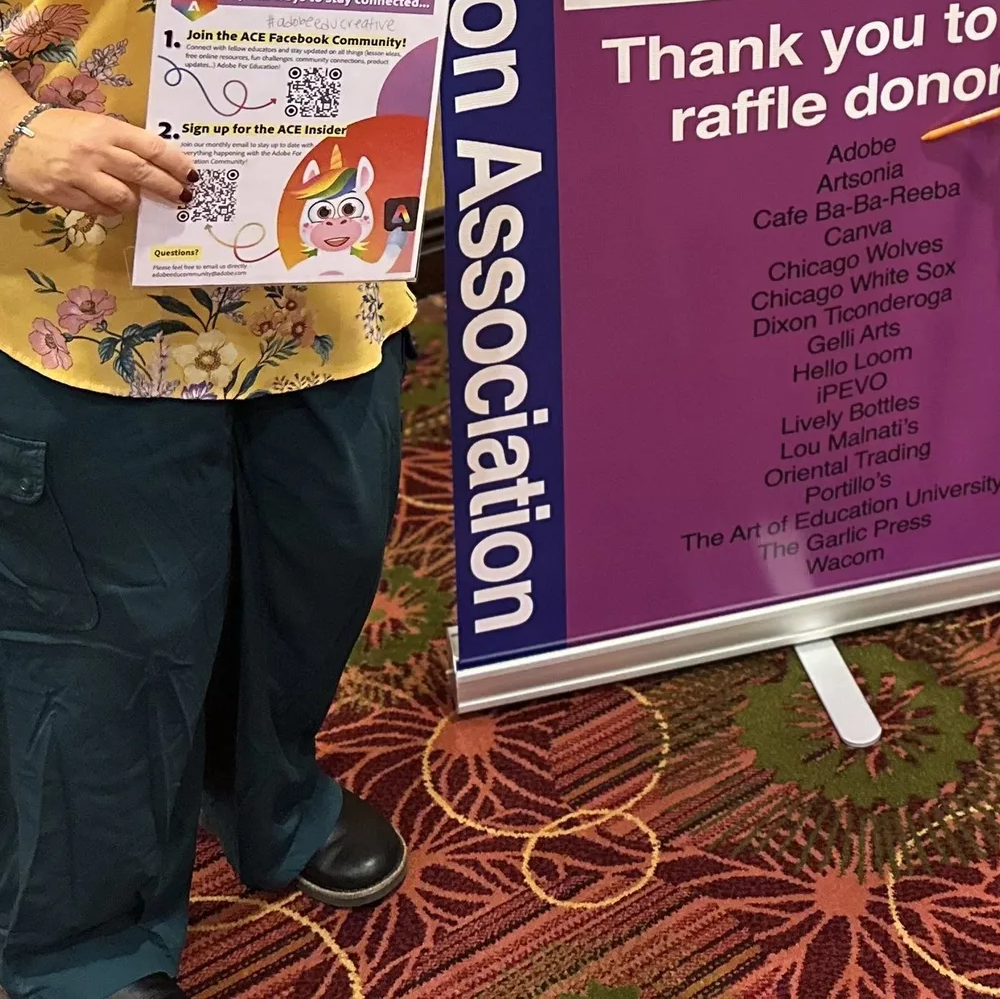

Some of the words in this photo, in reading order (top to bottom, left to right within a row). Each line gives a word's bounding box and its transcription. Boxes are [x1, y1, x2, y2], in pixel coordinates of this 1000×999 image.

[164, 29, 181, 48] 1.
[187, 29, 214, 41] Join
[217, 30, 238, 42] the
[240, 32, 266, 42] ACE
[269, 32, 330, 45] Facebook
[332, 35, 407, 49] Community!
[303, 47, 328, 55] updated
[601, 23, 804, 85] Thank
[820, 12, 925, 75] you
[943, 1, 998, 44] to
[216, 61, 237, 69] Adobe
[238, 62, 248, 70] For
[158, 121, 180, 140] 2.
[182, 123, 210, 136] Sign
[213, 125, 230, 136] up
[232, 123, 251, 134] for
[254, 124, 275, 134] the
[277, 124, 302, 135] ACE
[304, 124, 347, 135] Insider
[671, 87, 827, 142] raffle
[826, 137, 897, 165] Adobe
[816, 162, 904, 194] Artsonia
[753, 205, 808, 230] Cafe
[815, 181, 961, 222] Ba-Ba-Reeba
[824, 219, 892, 246] Canva
[154, 249, 199, 257] Questions?
[768, 253, 860, 282] Chicago
[866, 237, 943, 263] Wolves
[751, 283, 843, 311] Chicago
[850, 268, 909, 293] White
[916, 260, 956, 282] Sox
[753, 315, 817, 338] Dixon
[824, 287, 953, 326] Ticonderoga
[807, 328, 855, 354] Gelli
[859, 321, 901, 344] Arts
[793, 358, 848, 383] Hello
[854, 345, 913, 370] Loom
[455, 138, 551, 635] Association
[816, 371, 888, 404] iPEVO
[781, 410, 843, 435] Lively
[850, 395, 920, 422] Bottles
[764, 455, 848, 488] Oriental
[854, 441, 931, 470] Trading
[780, 439, 821, 460] Lou
[680, 530, 724, 552] The
[729, 521, 761, 544] Art
[767, 515, 789, 536] of
[795, 496, 898, 531] Education
[758, 539, 799, 561] The
[806, 527, 868, 552] Garlic
[873, 512, 932, 539] Press
[805, 546, 885, 575] Wacom
